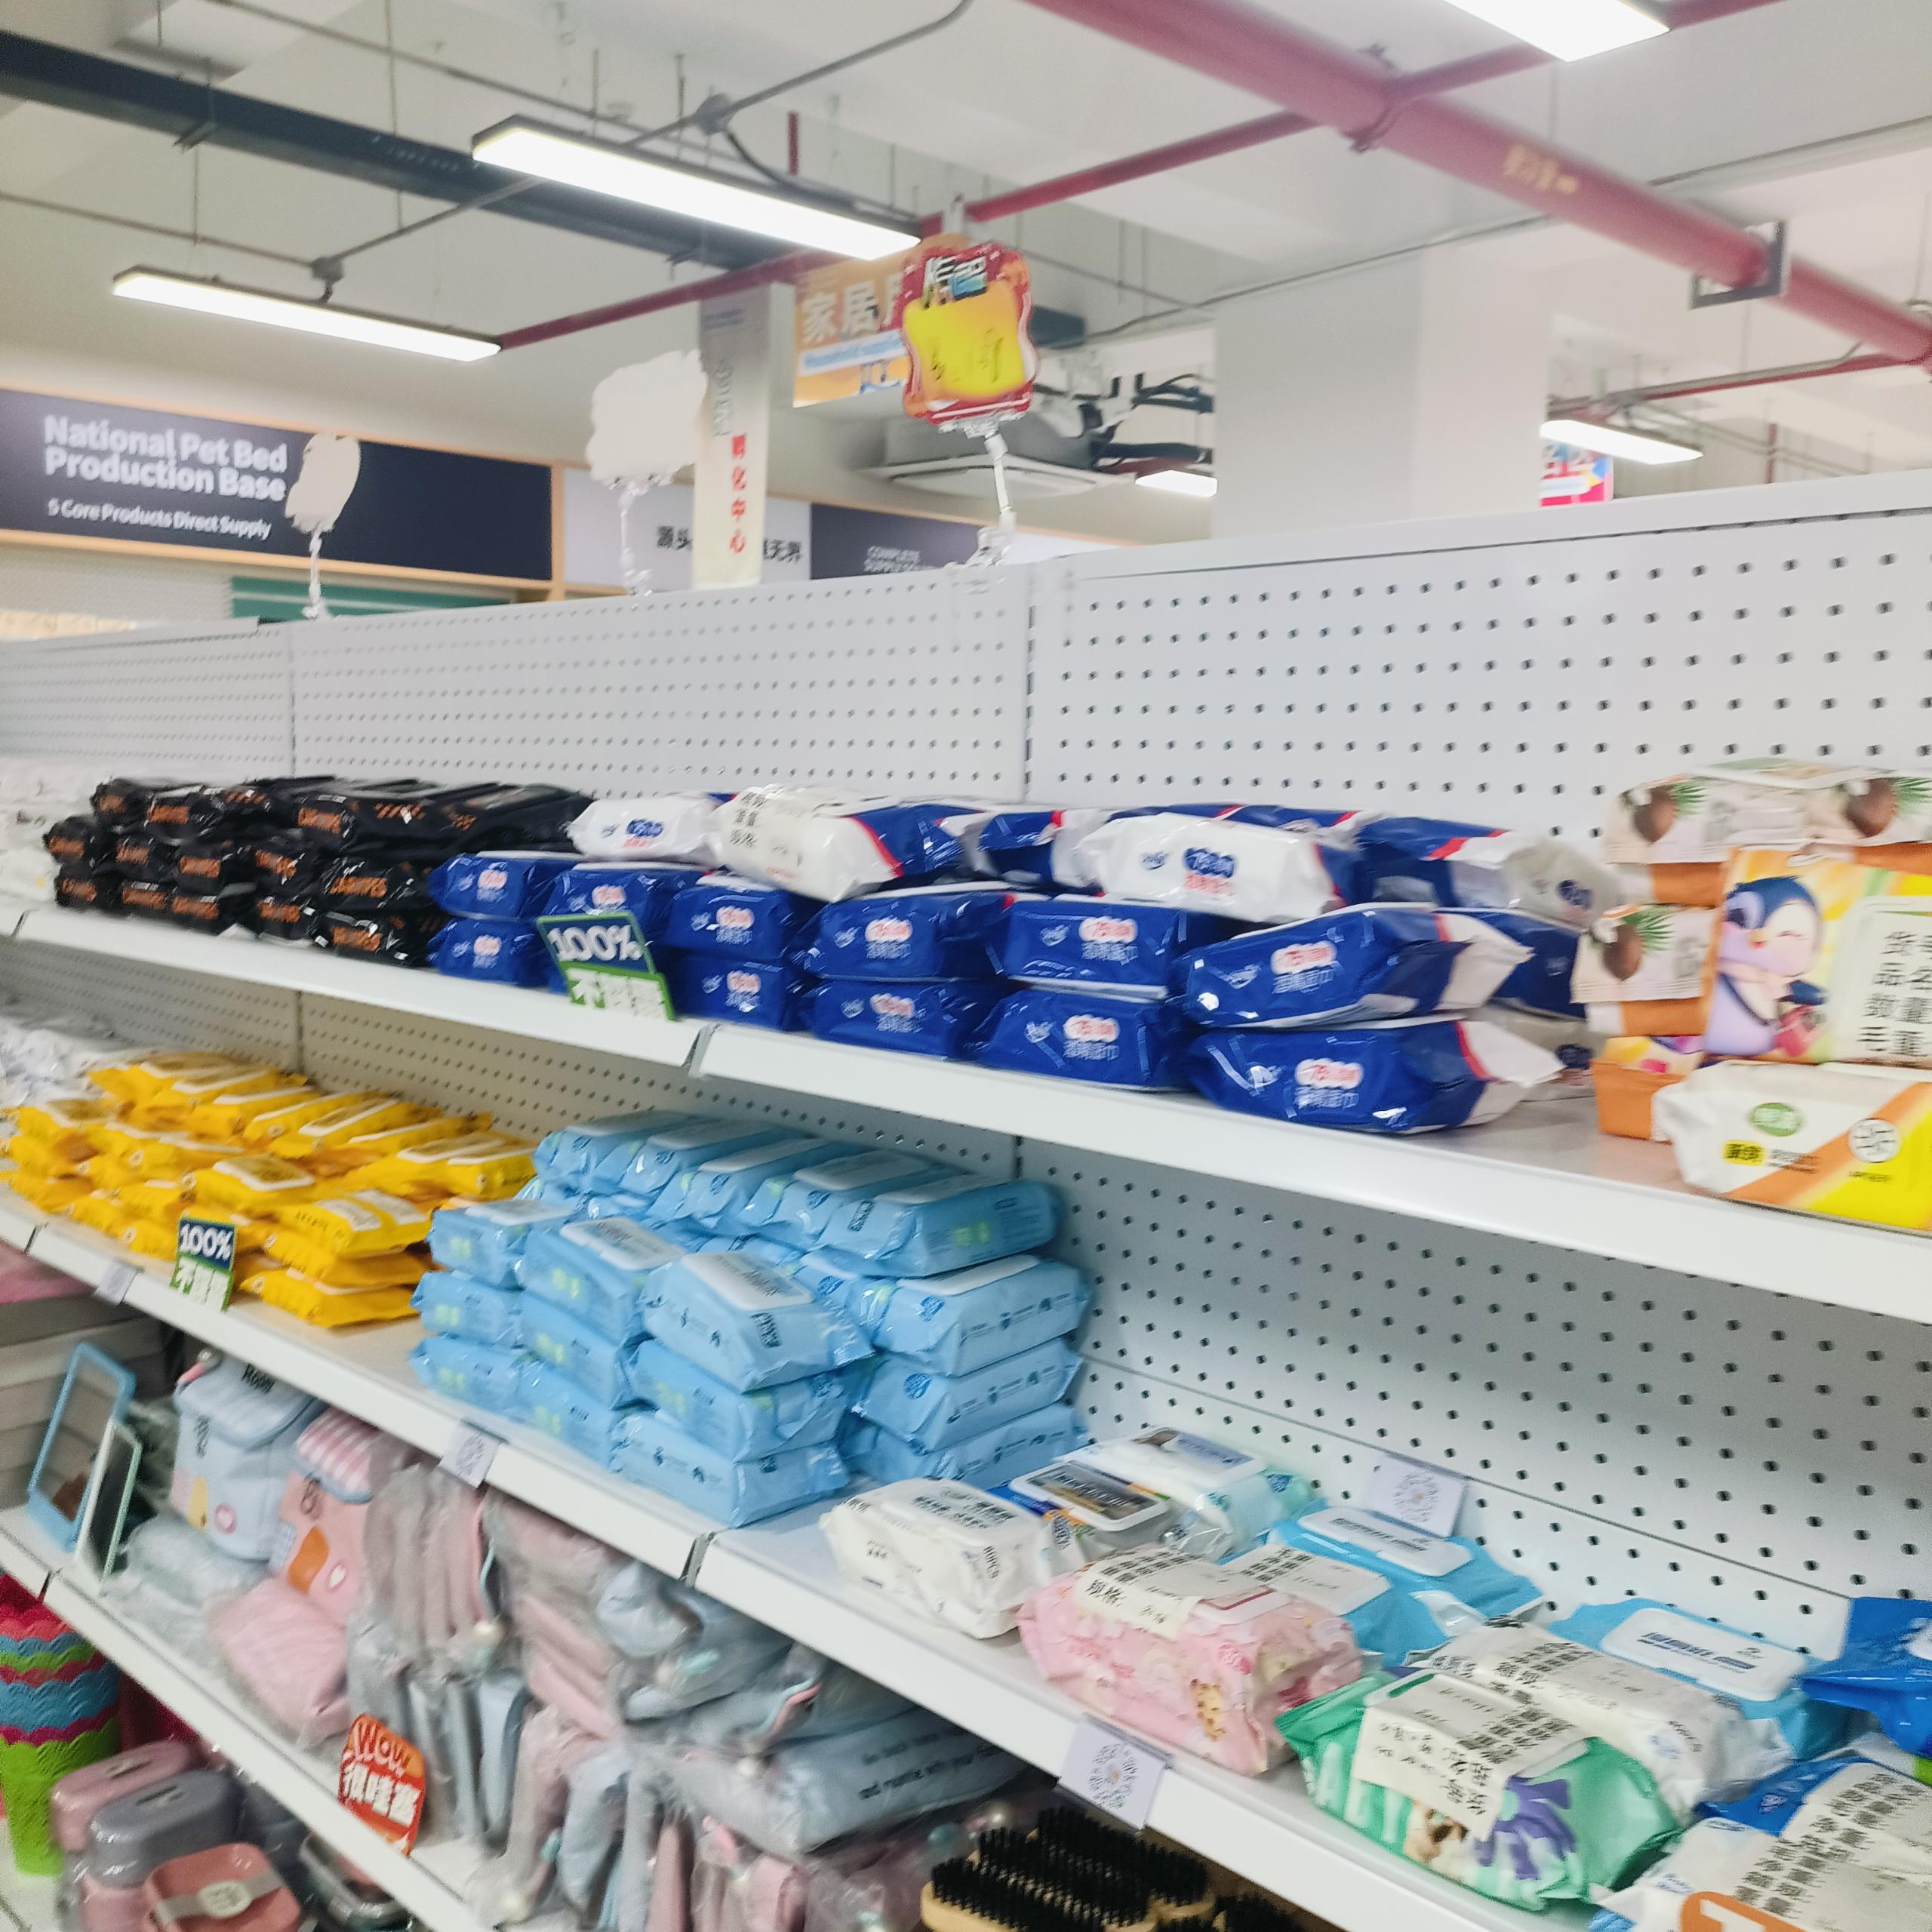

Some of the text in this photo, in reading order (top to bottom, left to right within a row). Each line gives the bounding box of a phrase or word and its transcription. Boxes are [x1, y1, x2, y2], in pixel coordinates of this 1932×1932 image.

[44, 414, 288, 473] National Pet Bed
[45, 445, 287, 502] Production Base
[61, 498, 100, 521] Core
[102, 503, 172, 528] Products
[174, 511, 218, 531] Direct
[220, 515, 272, 541] Supply
[546, 924, 644, 961] 100%
[180, 1223, 234, 1262] 100%
